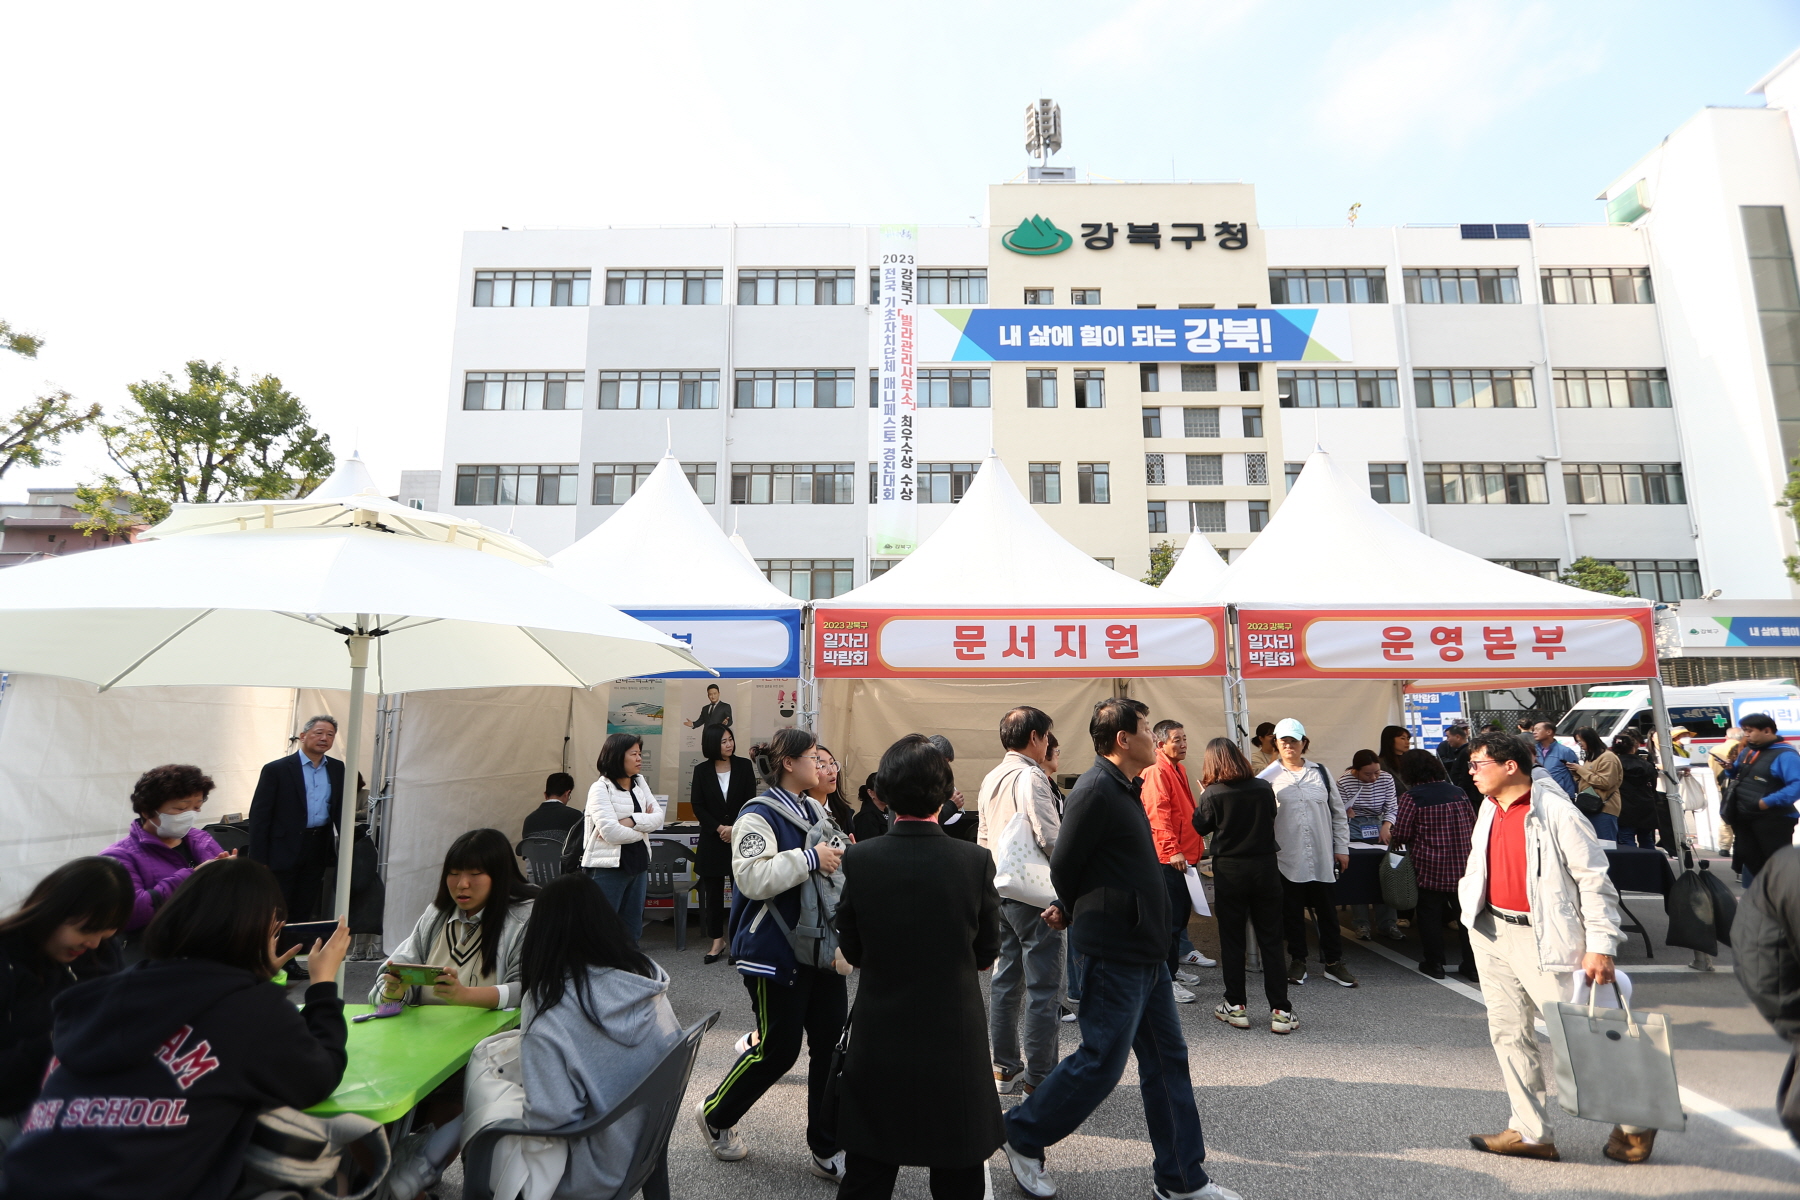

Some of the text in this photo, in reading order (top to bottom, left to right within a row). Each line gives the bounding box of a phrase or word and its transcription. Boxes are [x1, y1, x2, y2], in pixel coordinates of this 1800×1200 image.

[1081, 222, 1249, 250] 강북구청
[883, 254, 915, 265] 2023
[901, 268, 914, 305] 강북구
[999, 318, 1272, 354] 내 삶에 힘이 되는 강북!
[882, 267, 897, 501] 전국 기초자치단체 매니페스토 경진대회
[900, 415, 914, 469] 최우수상
[900, 474, 914, 501] 수상
[823, 621, 869, 630] 2023 강북구
[1246, 622, 1293, 631] 2023 강북구
[1749, 626, 1760, 637] 내
[1761, 627, 1780, 637] 삶에
[823, 632, 869, 649] 일자리
[953, 624, 1139, 661] 문서지원
[1247, 633, 1295, 650] 일자리
[1380, 625, 1567, 662] 운영본부
[823, 650, 869, 666] 박람회
[1249, 651, 1296, 668] 박람회
[61, 1098, 190, 1128] SCHOOL
